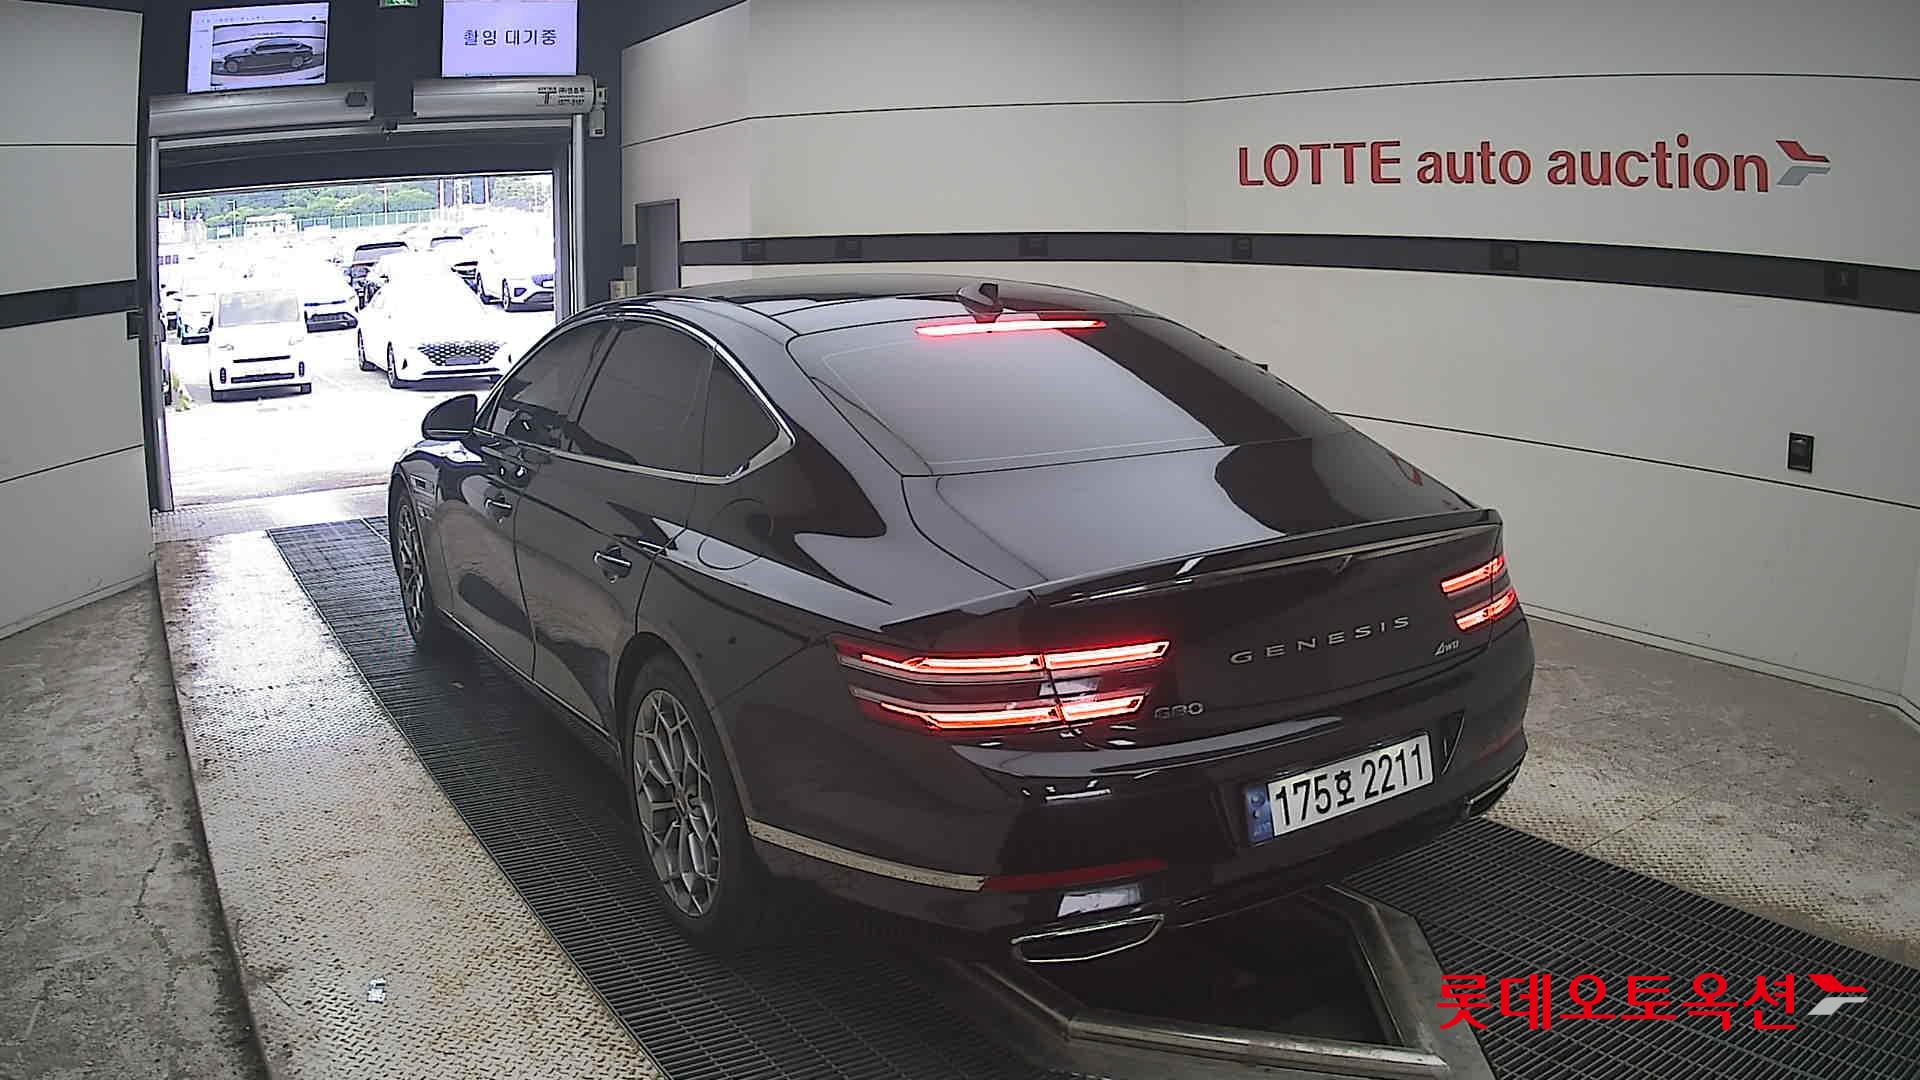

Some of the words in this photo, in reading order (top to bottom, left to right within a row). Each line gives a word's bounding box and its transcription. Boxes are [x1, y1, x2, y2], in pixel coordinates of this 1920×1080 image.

[504, 29, 558, 46] 대기중
[1240, 142, 1400, 187] LOTTE
[1417, 142, 1532, 184] auto
[1548, 133, 1769, 191] auction
[1229, 616, 1409, 664] GENESIS
[1275, 769, 1355, 826] 175호
[1361, 743, 1423, 800] 2211
